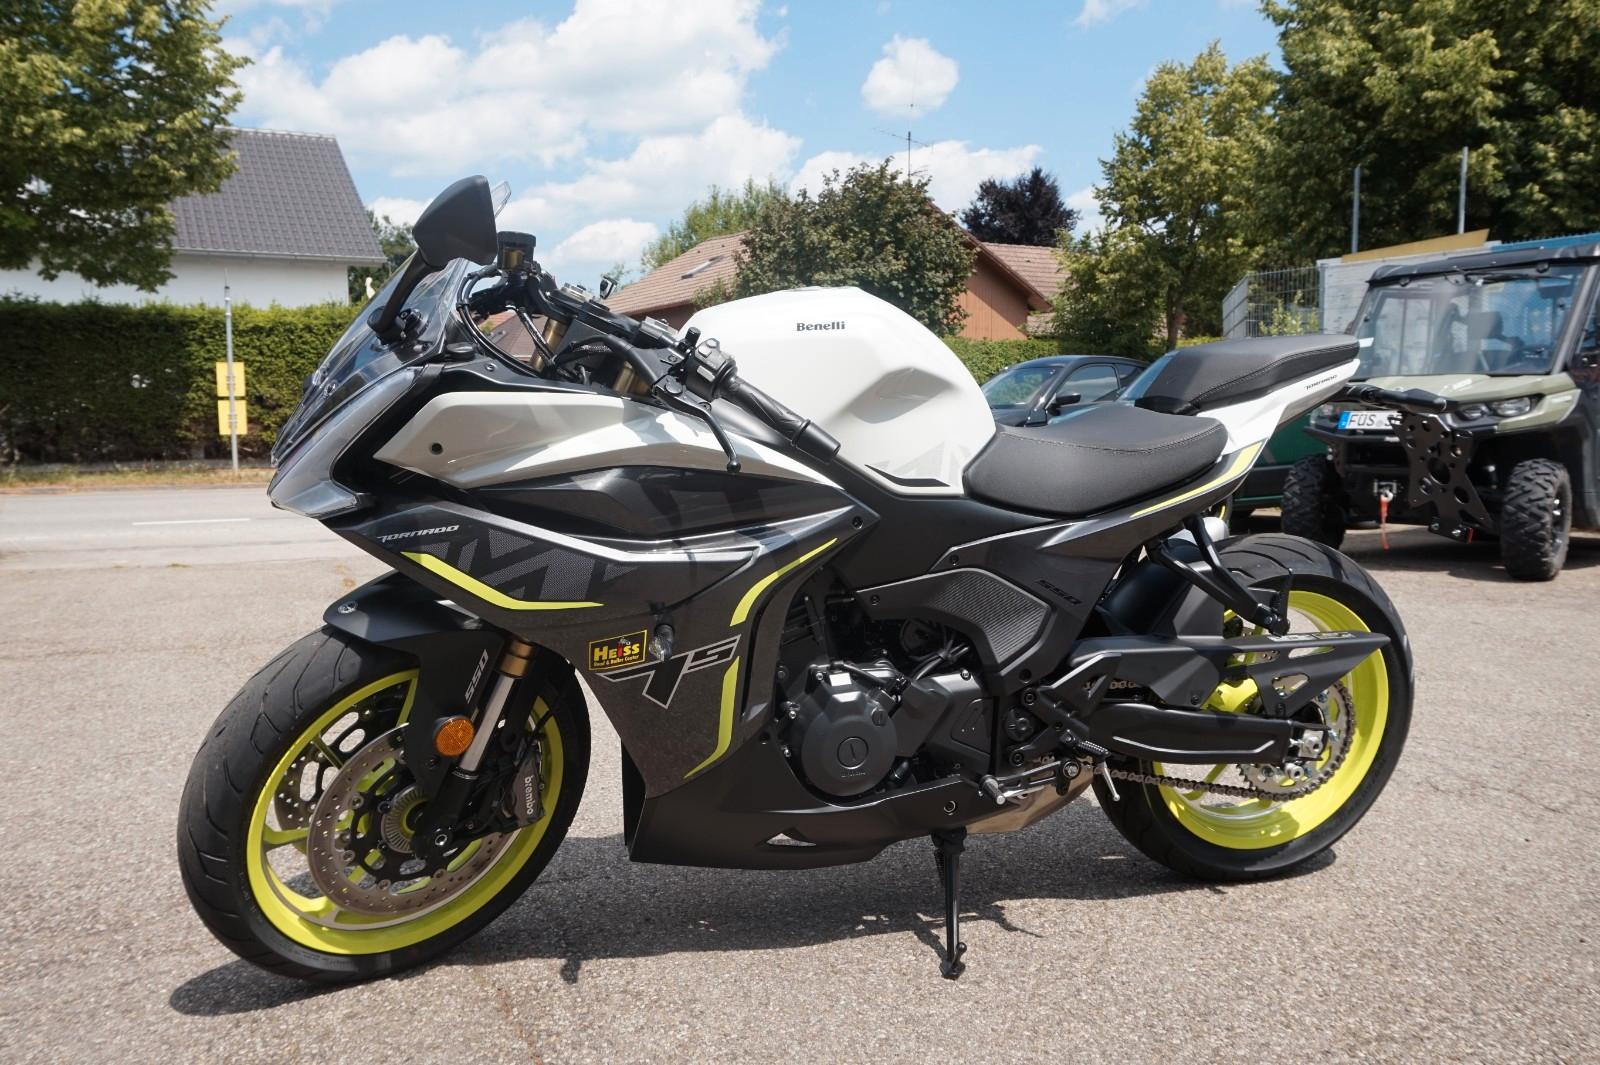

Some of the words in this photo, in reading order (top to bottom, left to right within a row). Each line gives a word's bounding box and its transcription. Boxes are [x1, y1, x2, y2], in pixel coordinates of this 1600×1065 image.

[796, 321, 846, 332] Benelli
[376, 525, 460, 543] TORNADO
[464, 649, 489, 704] 550
[524, 775, 536, 815] brembo
